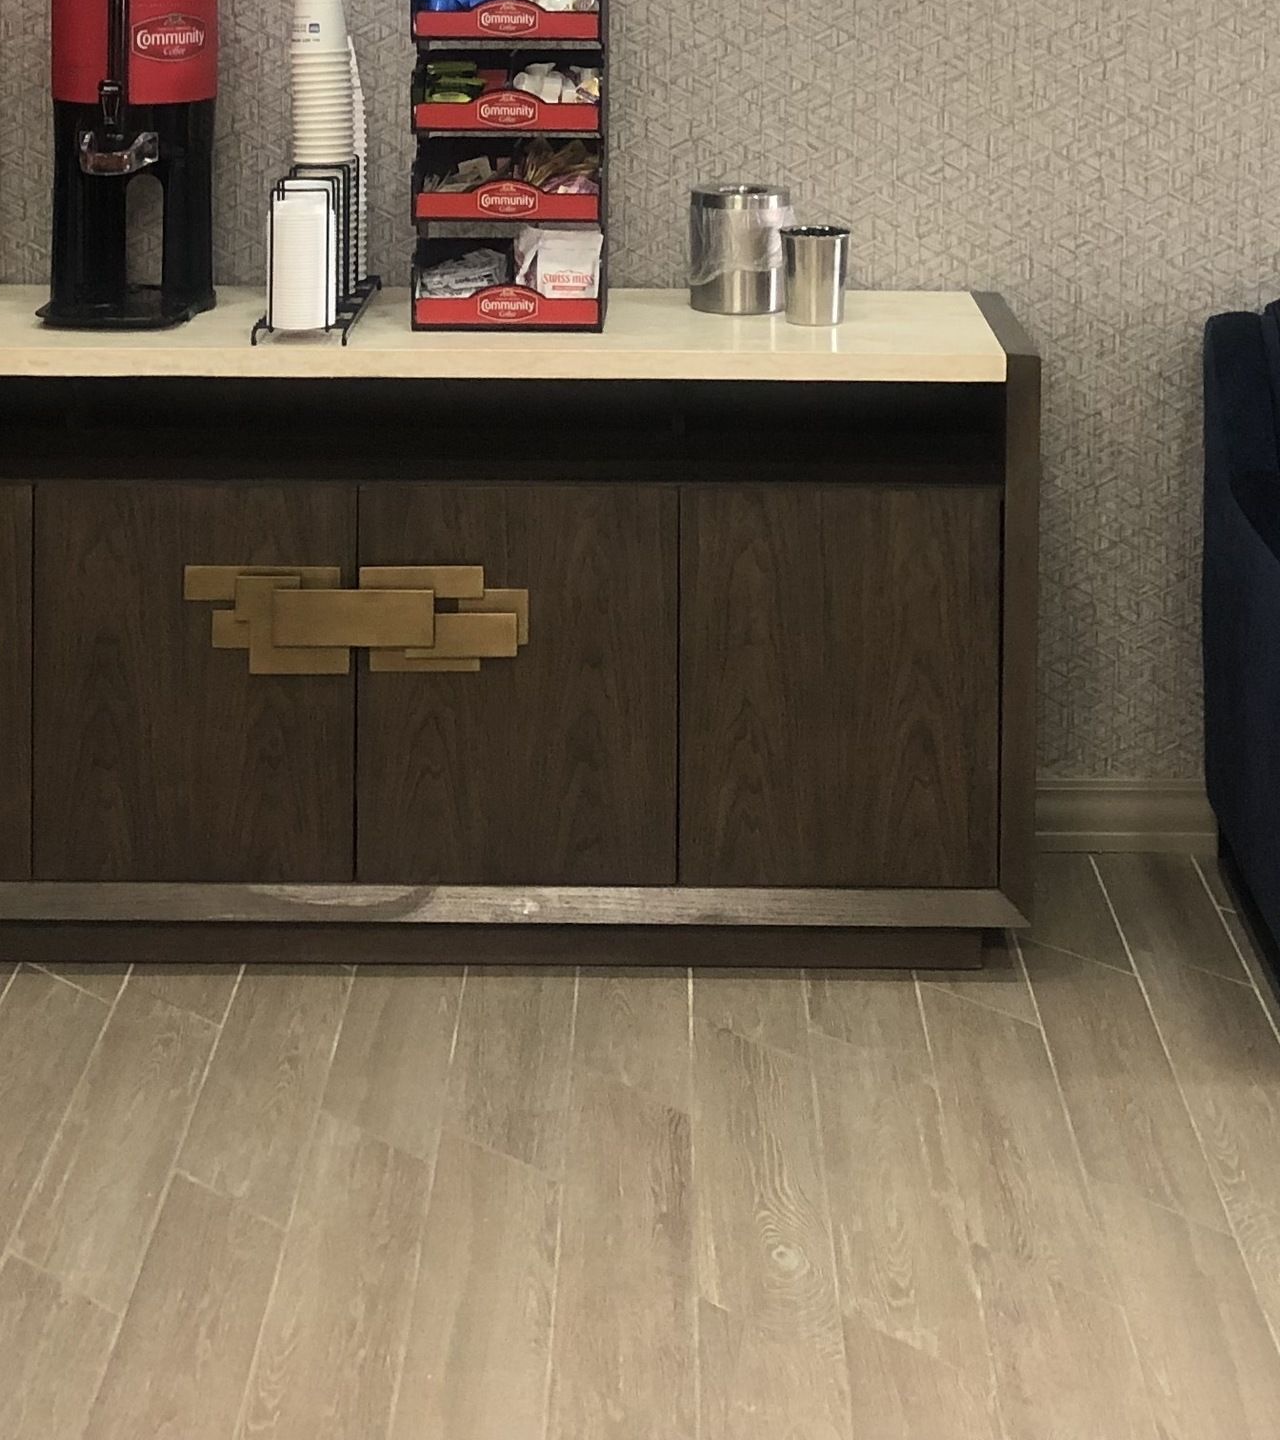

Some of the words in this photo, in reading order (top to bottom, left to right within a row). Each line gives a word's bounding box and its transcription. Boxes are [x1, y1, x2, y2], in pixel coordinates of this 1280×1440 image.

[481, 12, 535, 27] Community
[136, 27, 205, 50] Community
[480, 104, 534, 118] Community
[481, 193, 535, 208] Community
[481, 298, 535, 313] Community
